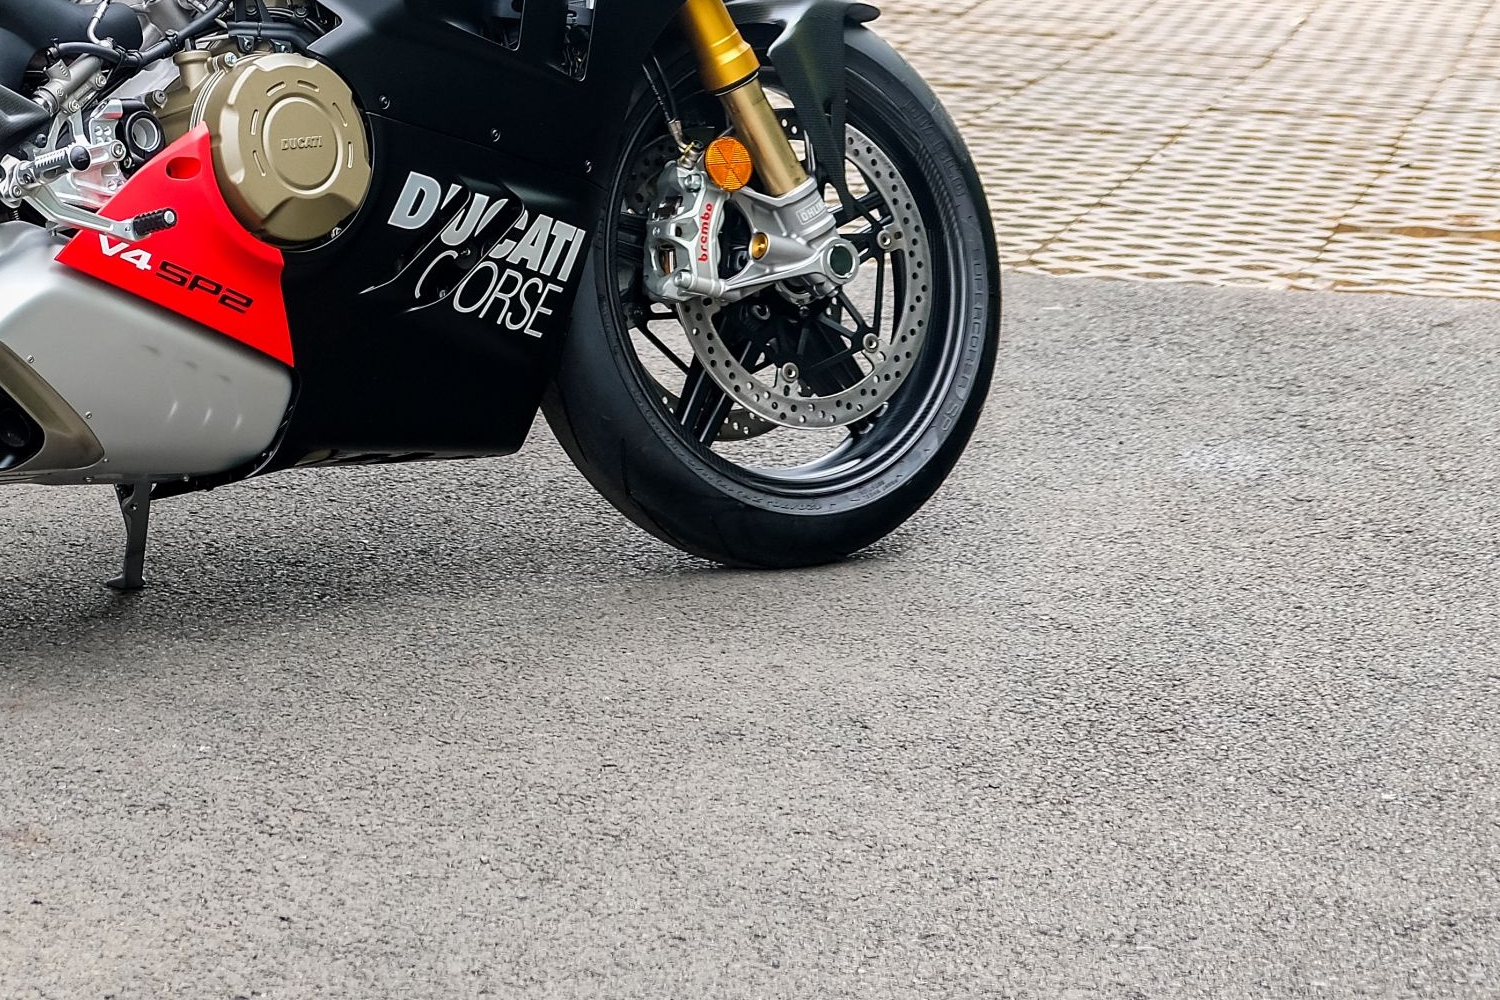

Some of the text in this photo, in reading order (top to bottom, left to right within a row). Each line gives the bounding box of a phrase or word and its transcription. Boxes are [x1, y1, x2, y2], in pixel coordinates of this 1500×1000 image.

[280, 135, 323, 151] DUCATI
[386, 170, 587, 283] DUCATI
[698, 203, 714, 263] brembo
[98, 233, 254, 314] V4 SP2
[414, 249, 565, 339] CORSE
